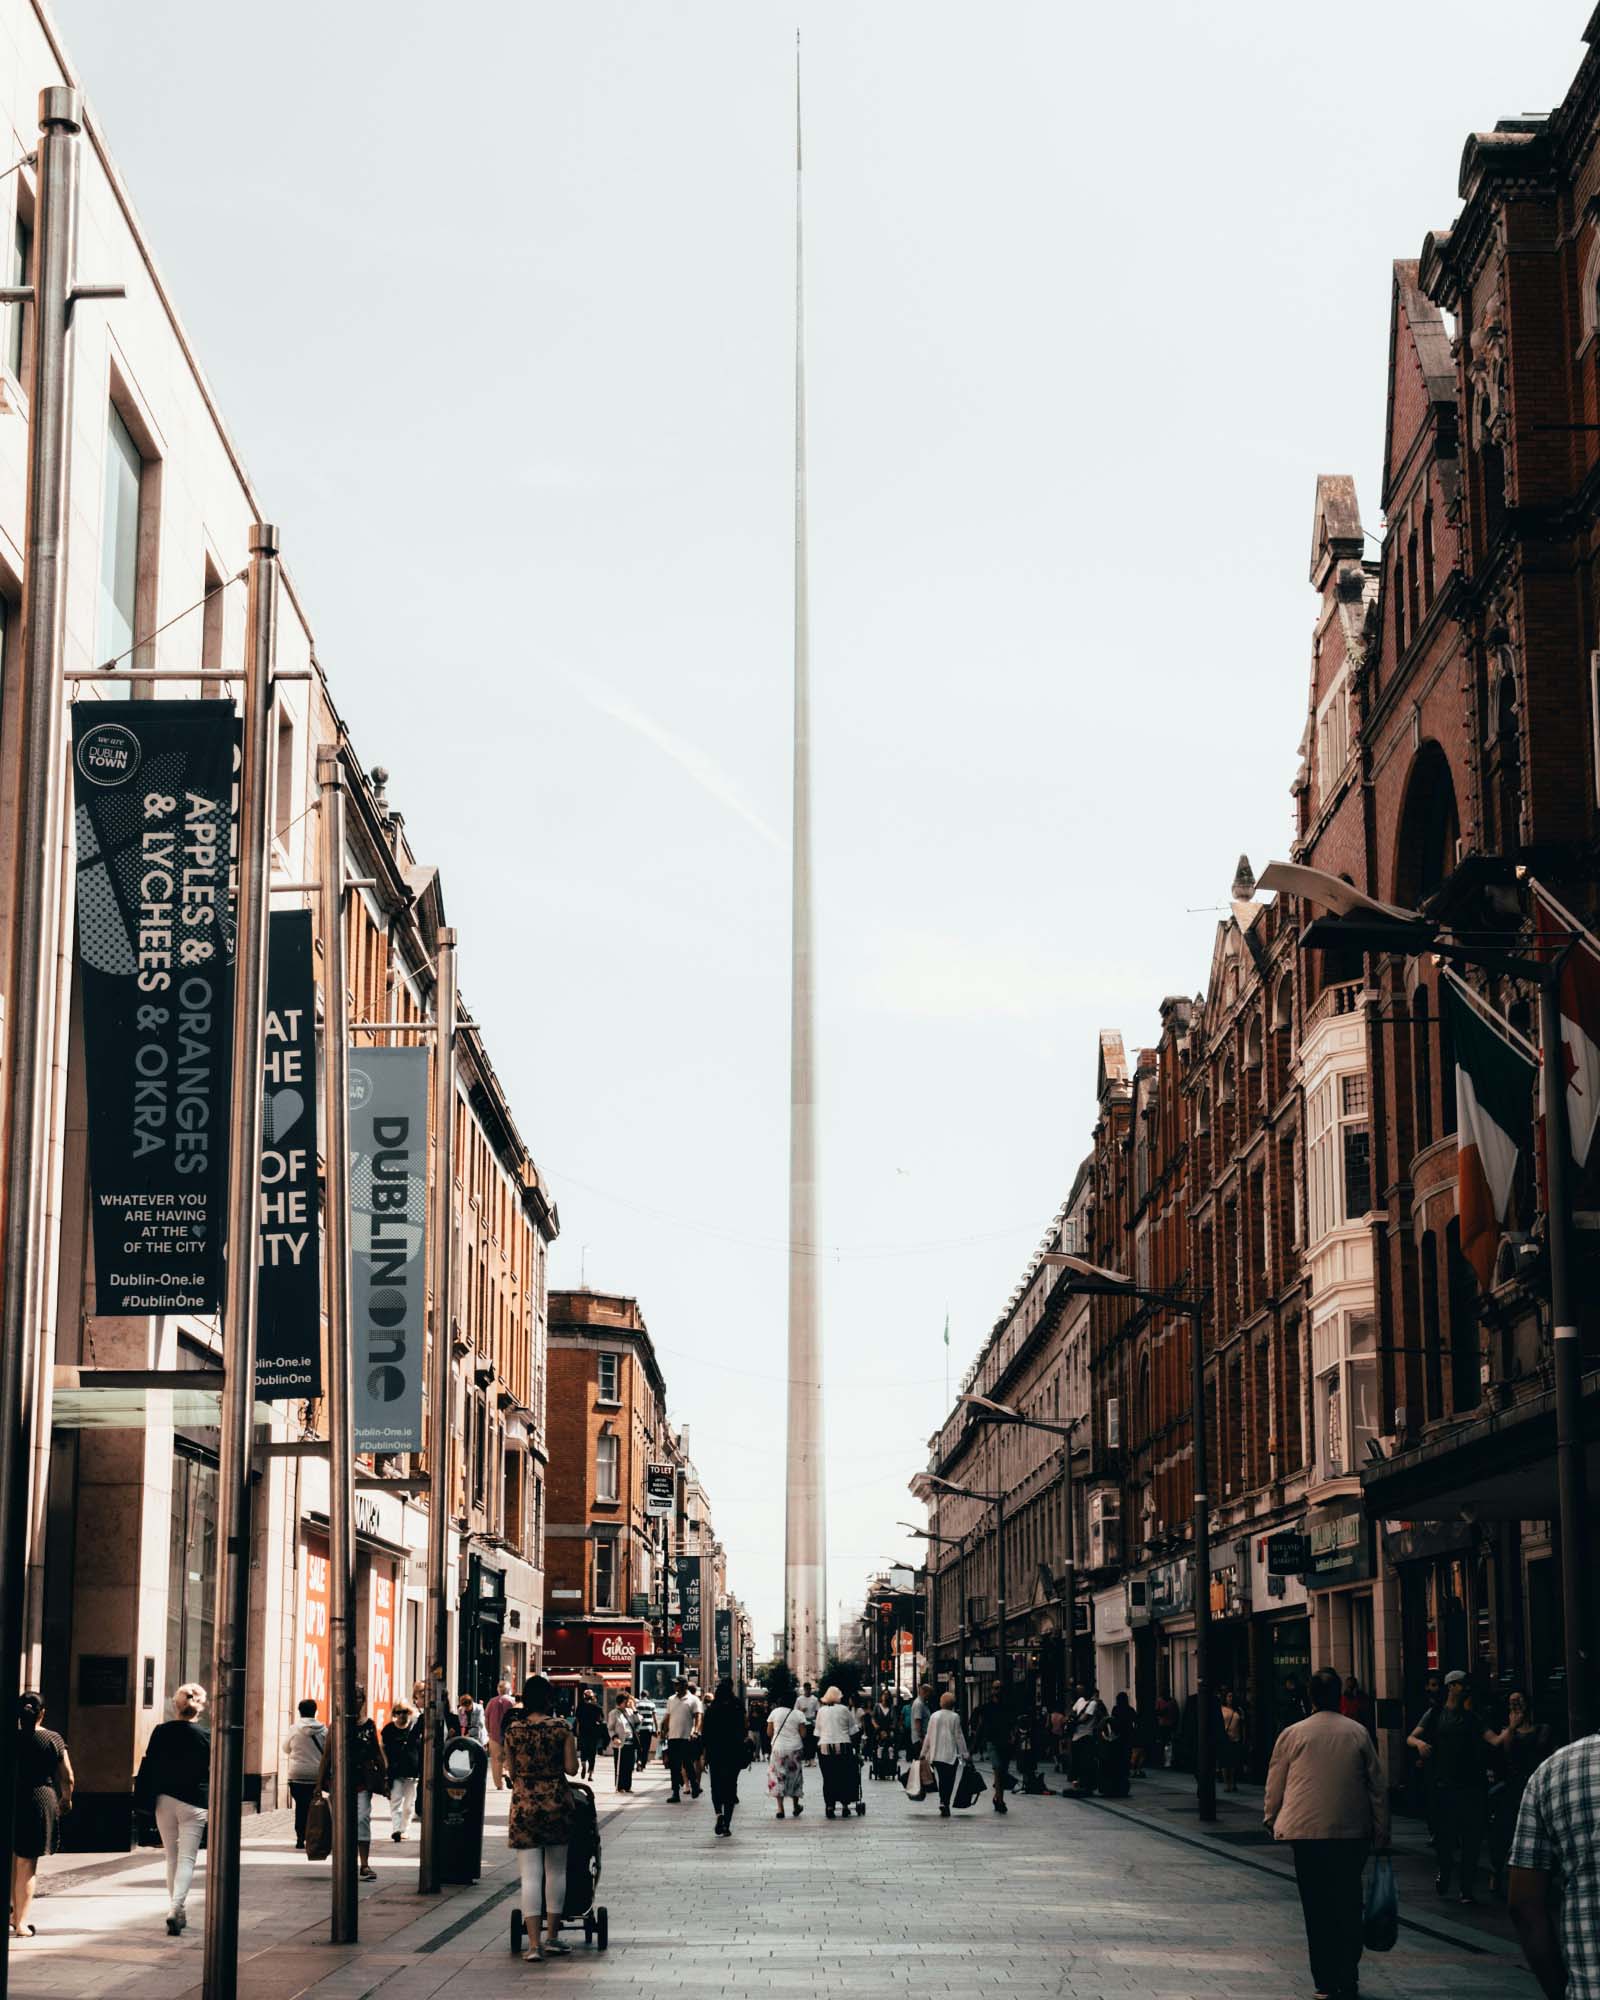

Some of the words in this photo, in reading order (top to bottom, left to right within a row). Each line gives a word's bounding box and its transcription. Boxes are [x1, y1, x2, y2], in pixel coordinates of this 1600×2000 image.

[89, 746, 128, 760] DUBLIN
[89, 755, 127, 769] TOWN
[143, 792, 177, 819] &
[180, 792, 217, 927] APPLES
[137, 832, 177, 992] LYCHEES
[179, 938, 214, 967] &
[135, 1004, 170, 1032] &
[264, 1009, 303, 1042] AT
[263, 1050, 303, 1084] HE
[174, 977, 213, 1174] ORANGES
[133, 1043, 169, 1159] OKRA
[260, 1149, 307, 1184] OF
[100, 1194, 175, 1206] WHATEVER
[178, 1194, 207, 1206] YOU
[260, 1191, 308, 1225] HE
[124, 1210, 153, 1222] ARE
[156, 1210, 207, 1221] HAVING
[141, 1226, 158, 1237] AT
[162, 1226, 189, 1237] THE
[123, 1241, 142, 1253] OF
[145, 1241, 173, 1253] THE
[175, 1241, 207, 1253] CITY
[110, 1273, 206, 1286] Dublin-One.ie
[121, 1294, 205, 1308] #DublinOne
[255, 1373, 312, 1386] DublinOne
[360, 1441, 412, 1450] #DublinOne
[650, 1466, 661, 1474] TO
[308, 1554, 327, 1593] SALE
[686, 1587, 700, 1595] THE
[682, 1623, 700, 1631] CITY
